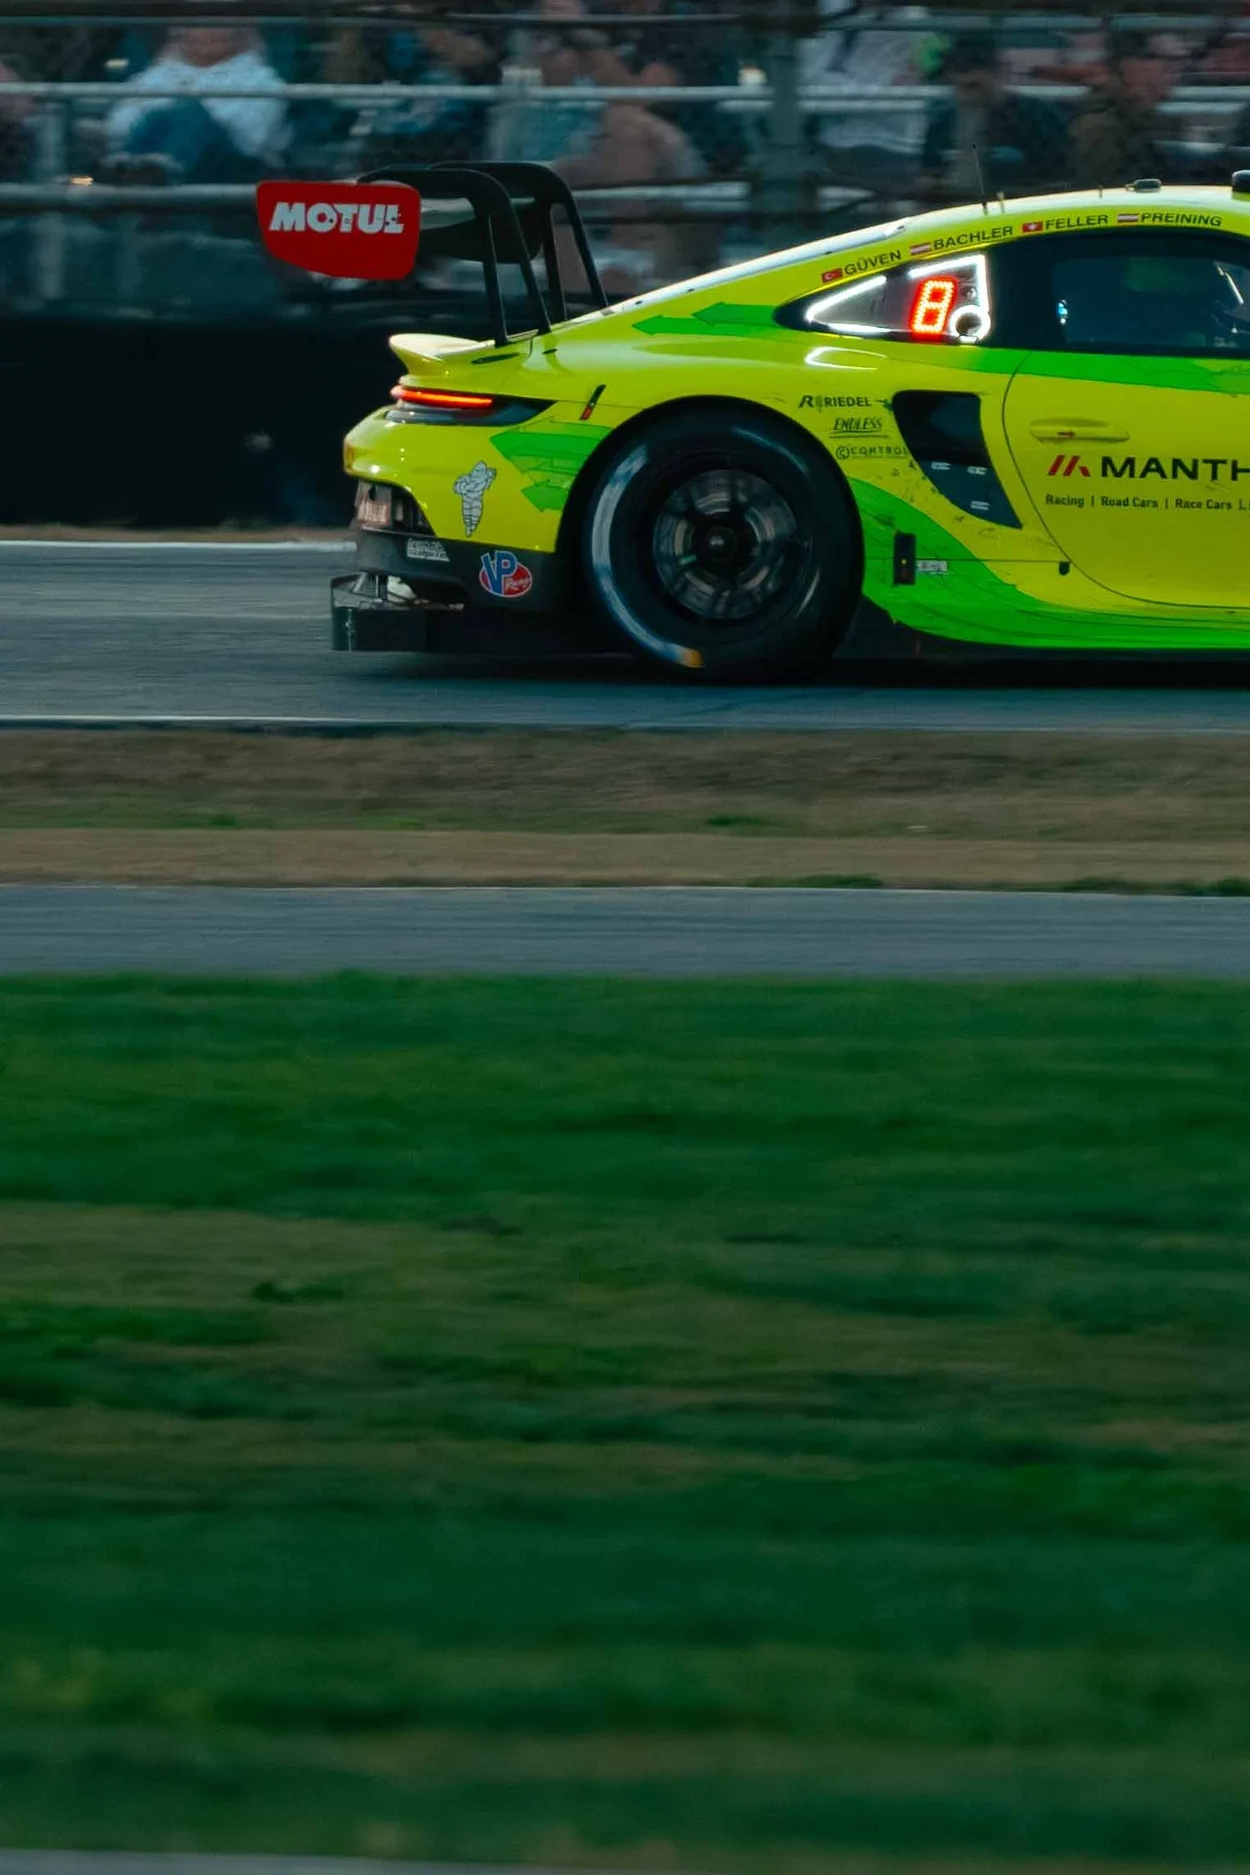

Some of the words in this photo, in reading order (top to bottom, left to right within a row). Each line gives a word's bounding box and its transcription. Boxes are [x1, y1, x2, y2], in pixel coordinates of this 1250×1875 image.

[269, 201, 405, 234] MOTUL
[843, 248, 902, 276] GÜVEN
[933, 225, 1014, 252] BACHLER
[1045, 213, 1109, 231] FELLER
[1140, 211, 1223, 228] PREINING
[824, 396, 872, 408] RIEDEL
[833, 416, 884, 431] ENDLESS
[1045, 494, 1085, 508] Racing
[1100, 495, 1130, 508] Road
[1132, 496, 1159, 509] Cars
[1175, 498, 1203, 510] Race
[1206, 498, 1232, 510] Cars
